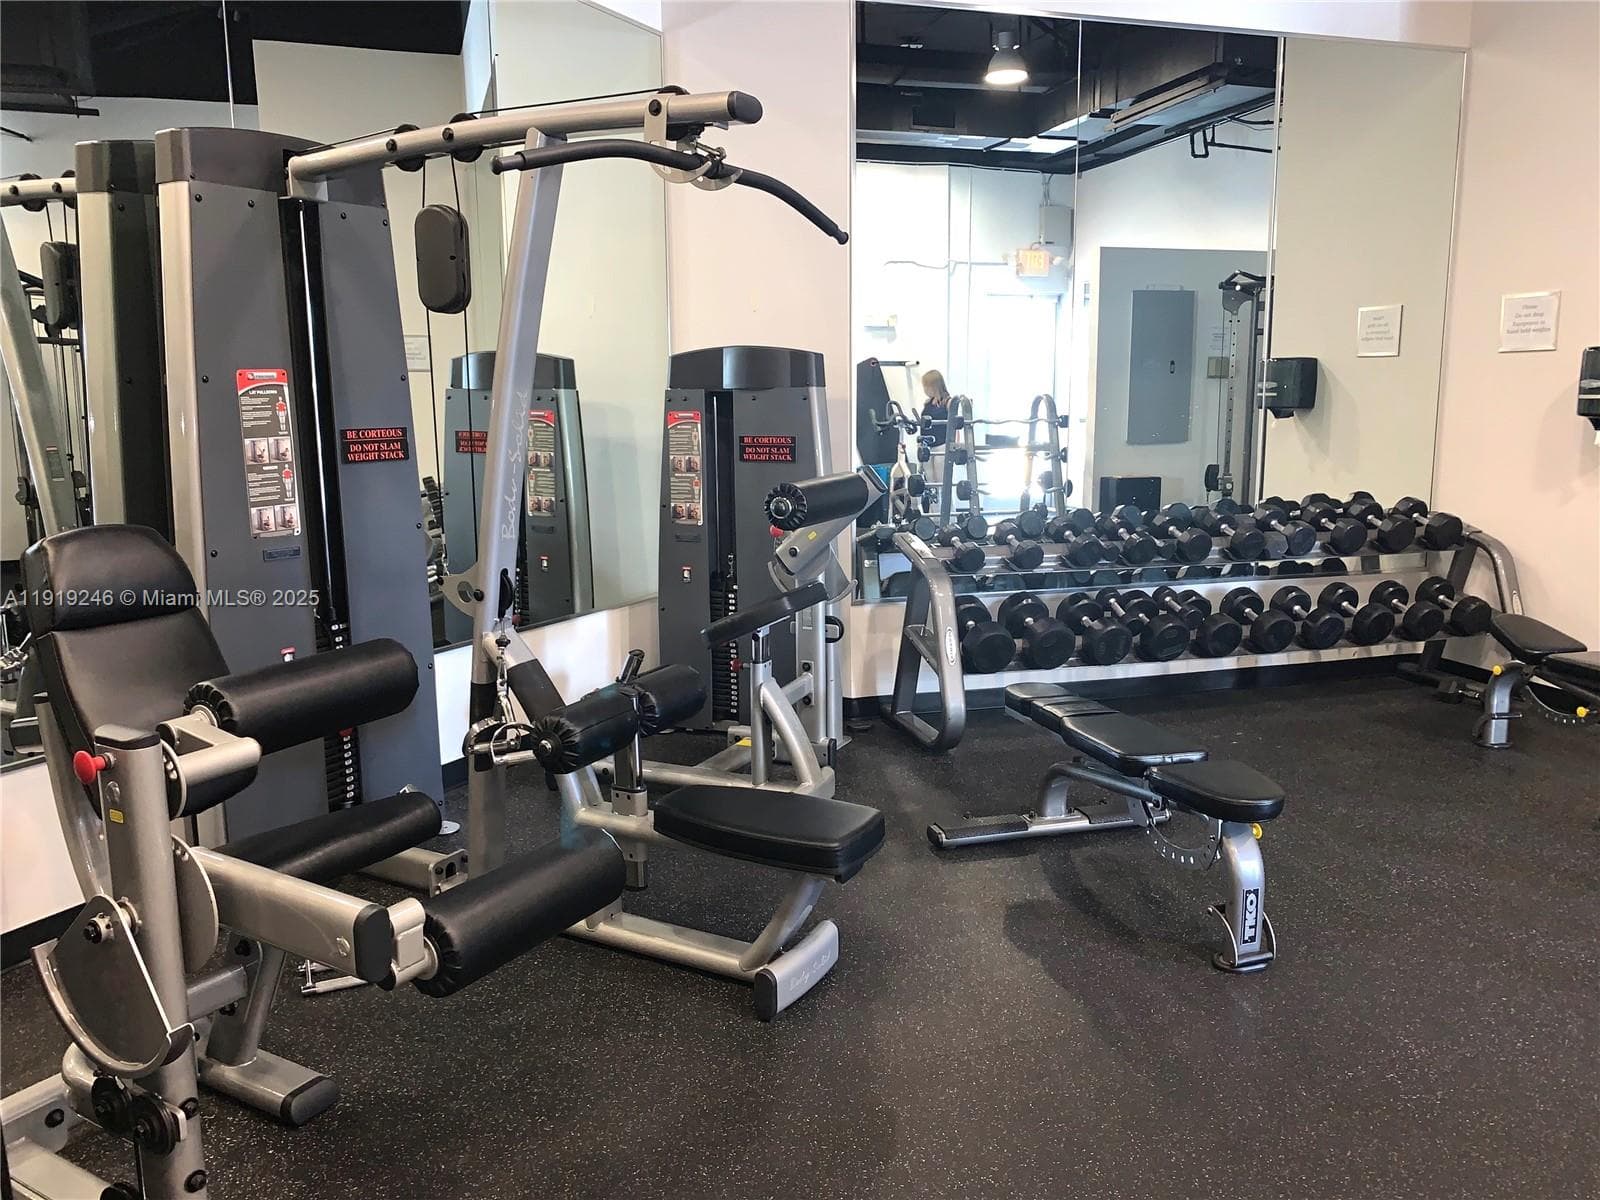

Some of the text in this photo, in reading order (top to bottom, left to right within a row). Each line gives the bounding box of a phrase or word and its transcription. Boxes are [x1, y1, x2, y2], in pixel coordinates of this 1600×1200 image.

[346, 428, 403, 439] BE CORTEOUS
[743, 436, 792, 444] BE CORTEOUS
[350, 441, 401, 452] DO NOT SLAM
[347, 450, 405, 462] WEIGHT STACK
[1245, 892, 1257, 941] TKO
